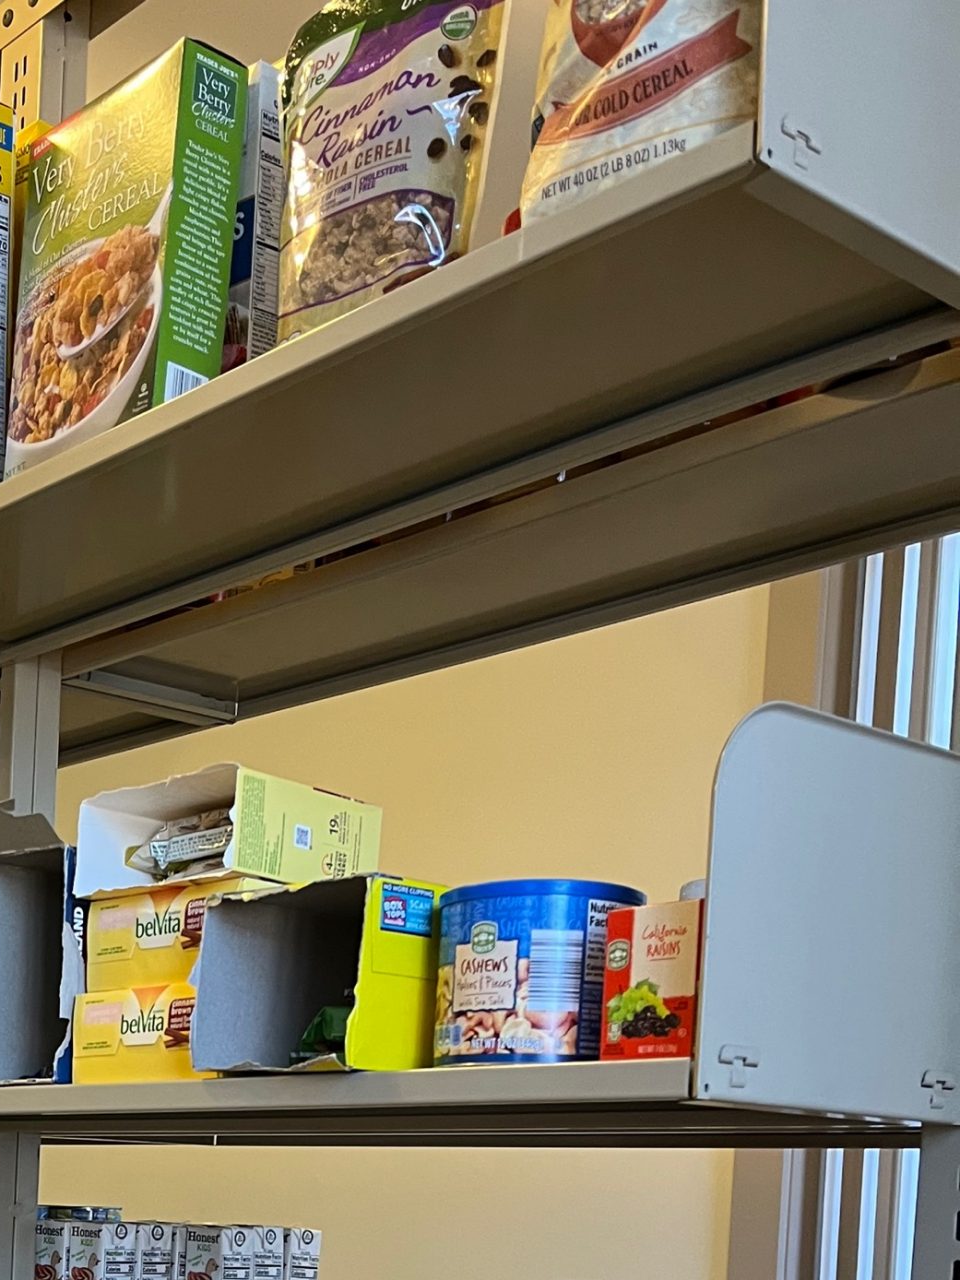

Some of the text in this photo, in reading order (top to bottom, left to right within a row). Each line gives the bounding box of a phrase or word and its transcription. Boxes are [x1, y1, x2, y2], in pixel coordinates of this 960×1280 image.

[196, 53, 236, 78] TRADER JOE'S
[615, 41, 659, 70] GRAIN
[202, 67, 231, 98] Very
[593, 60, 694, 120] COLD CEREAL
[197, 84, 231, 116] Berry
[299, 69, 442, 146] Cinnamon
[191, 101, 236, 129] Clusters
[195, 120, 230, 144] CEREAL
[315, 110, 403, 169] Raisin
[32, 113, 146, 205] Very Berry
[354, 136, 413, 170] CEREAL
[359, 163, 409, 184] CHOLESTEROL
[541, 138, 687, 201] NET WT 40 OZ (2 LB 8 OZ) 1.13kg
[358, 180, 376, 194] FREE
[32, 152, 132, 256] Clusters
[87, 172, 164, 231] CEREAL
[384, 900, 404, 911] BOX
[385, 910, 407, 919] TOPS
[135, 905, 181, 940] belVita
[641, 924, 688, 945] California
[646, 940, 681, 957] RAISINS
[460, 956, 509, 976] CASHEWS
[486, 976, 512, 990] Pieces
[120, 1003, 165, 1036] belVita
[35, 1225, 64, 1237] Honest
[71, 1226, 103, 1239] Honest
[187, 1231, 221, 1244] Honest
